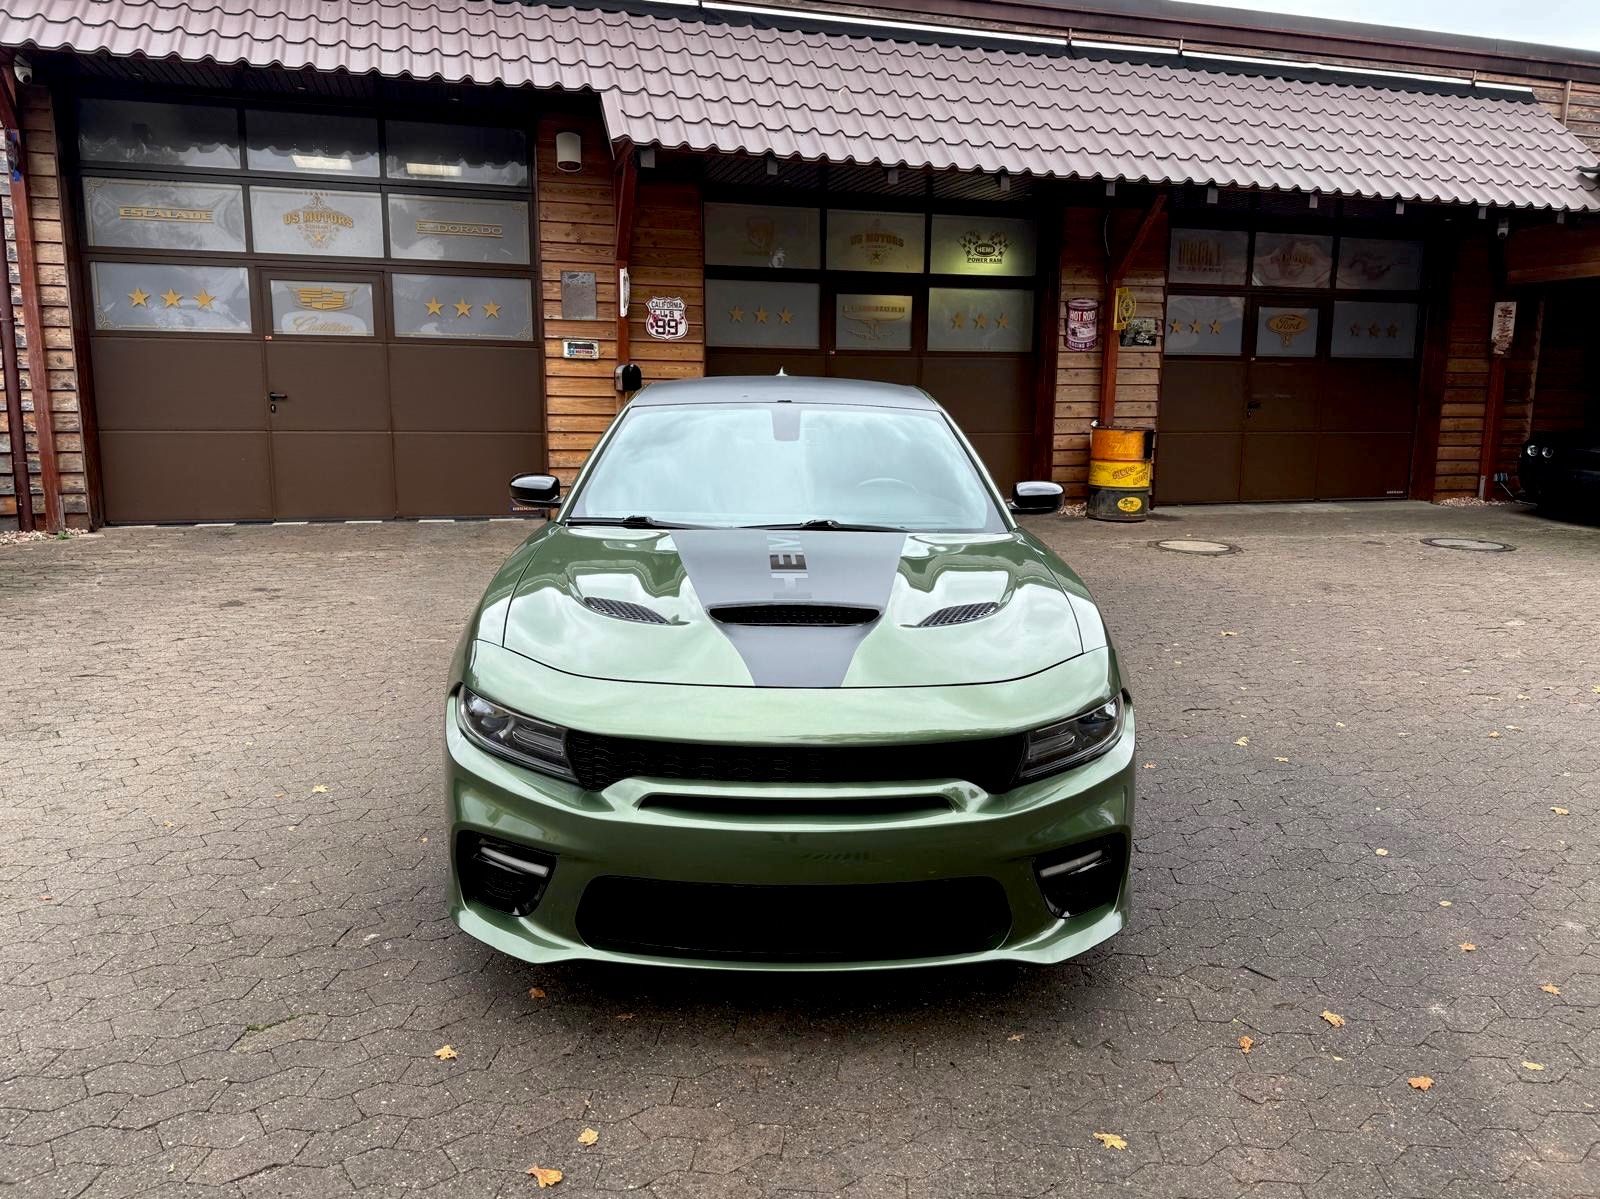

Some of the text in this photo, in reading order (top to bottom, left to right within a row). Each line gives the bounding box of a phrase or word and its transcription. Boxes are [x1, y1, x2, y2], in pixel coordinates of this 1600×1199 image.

[119, 207, 213, 220] ESCALADE
[283, 211, 300, 225] US
[303, 210, 353, 229] MOTORS
[416, 223, 502, 234] EDORADO
[1070, 310, 1096, 321] HOT ROD
[655, 319, 678, 335] 99
[1276, 318, 1302, 329] Ford
